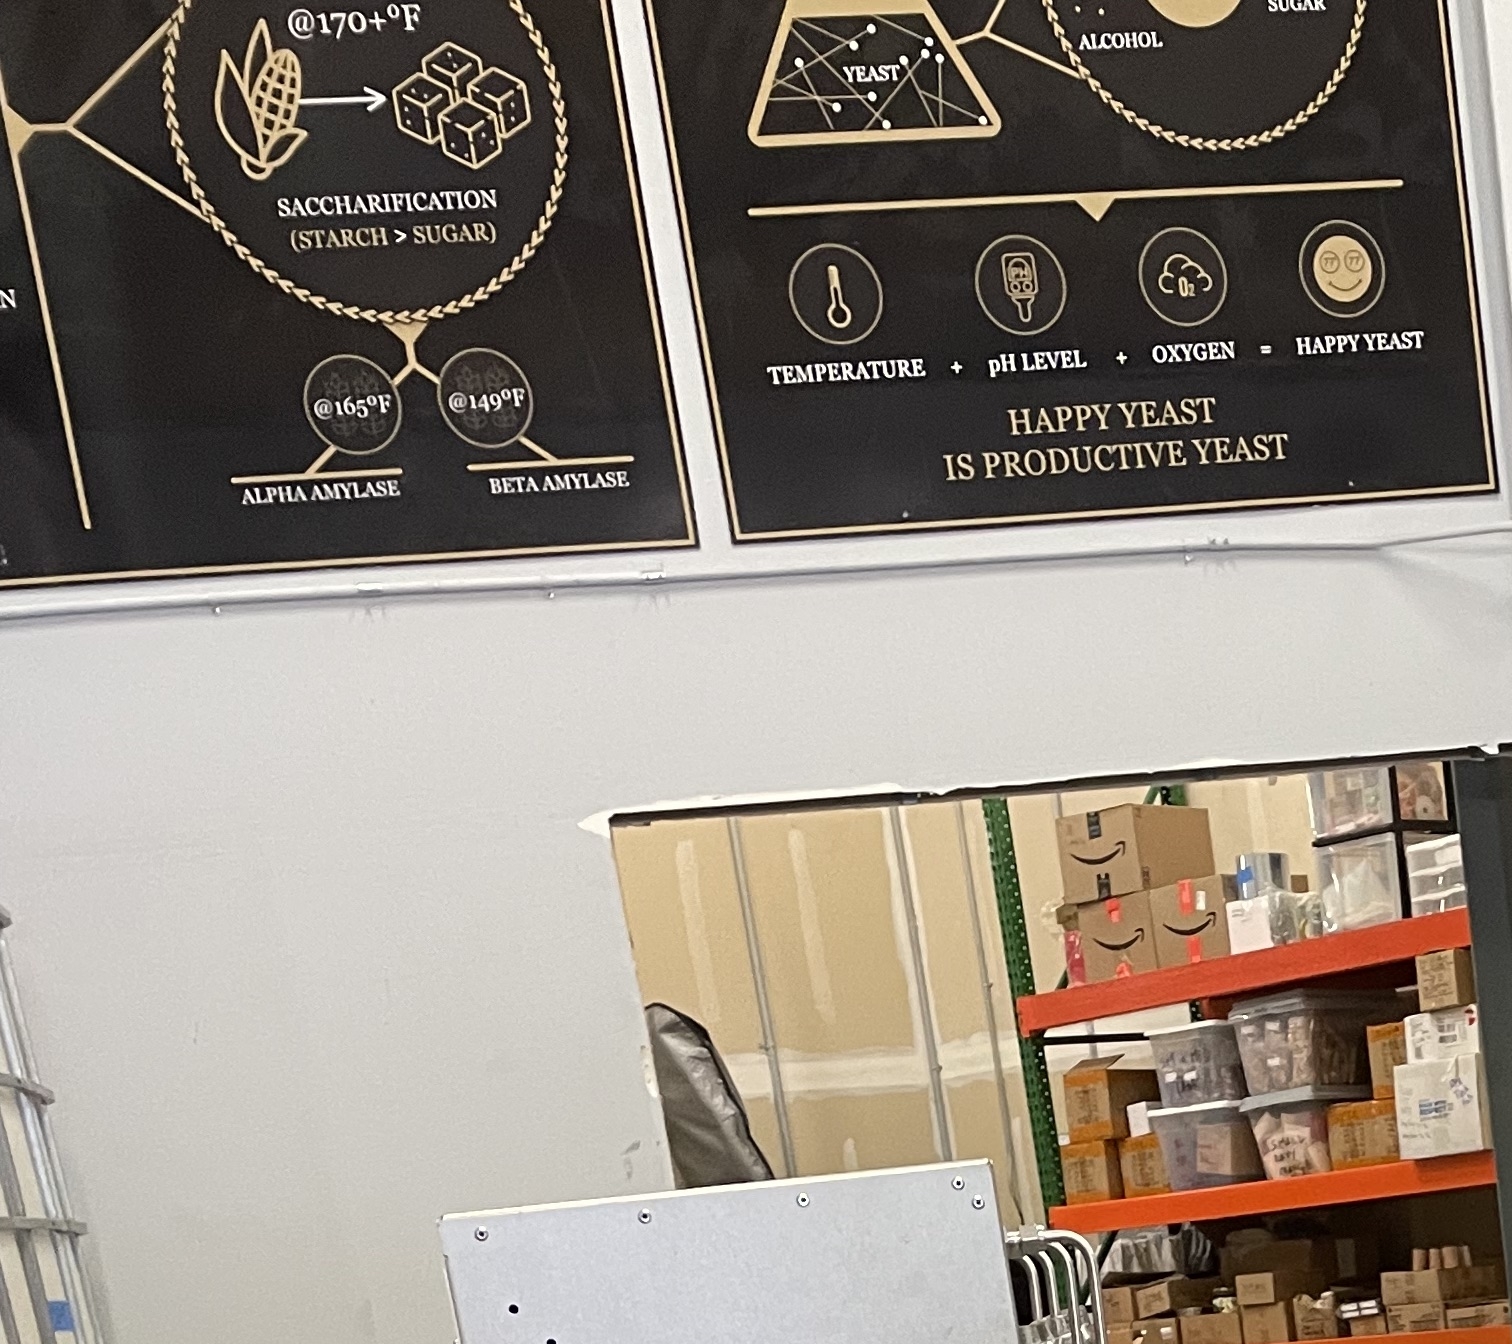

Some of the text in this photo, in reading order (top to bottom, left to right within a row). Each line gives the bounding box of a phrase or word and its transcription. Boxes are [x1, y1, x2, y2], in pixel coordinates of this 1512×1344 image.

[1078, 31, 1164, 51] ALCOHOL
[843, 64, 901, 84] YEAST
[277, 188, 498, 217] SACCHARIFICATION
[290, 226, 389, 253] (STARCH
[412, 221, 497, 246] SUGAR)
[767, 358, 926, 385] TEMPERATURE
[988, 353, 1017, 378] pH
[1022, 349, 1088, 371] LEVEL
[1152, 341, 1236, 363] OXYGEN
[1296, 333, 1360, 356] HAPPY
[1362, 330, 1425, 351] YEAST
[1007, 396, 1216, 436] HAPPY YEAST
[943, 432, 1288, 481] IS PRODUCTIVE YEAST
[241, 479, 401, 506] ALPHA AMYLASE
[488, 471, 630, 495] BETA AMYLASE
